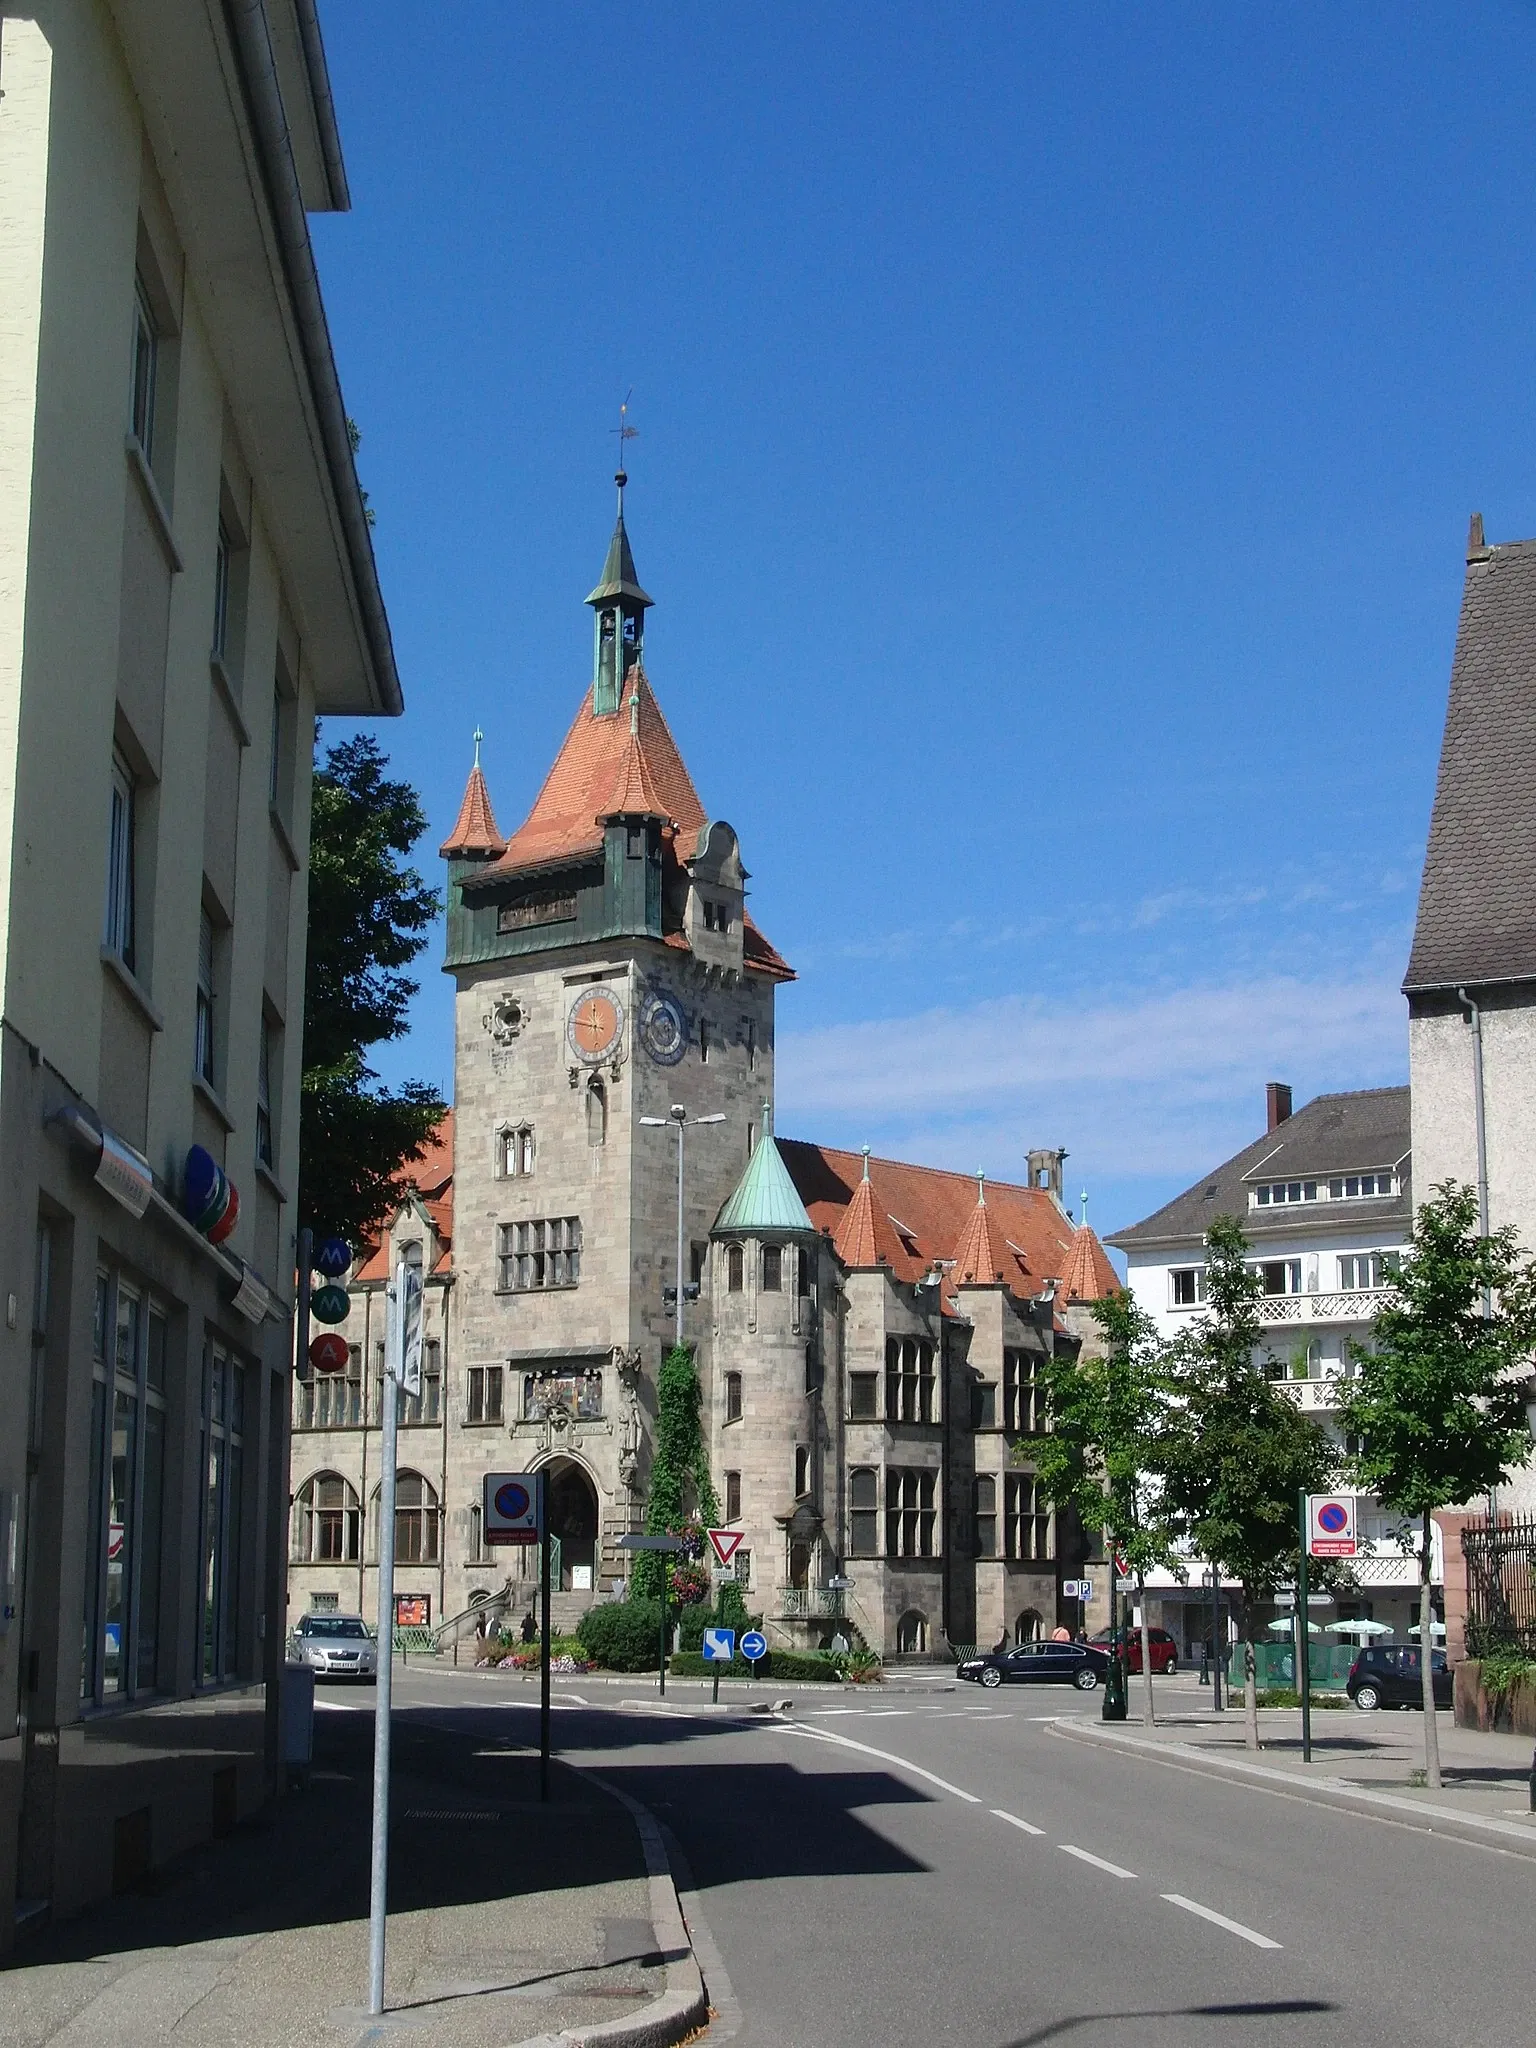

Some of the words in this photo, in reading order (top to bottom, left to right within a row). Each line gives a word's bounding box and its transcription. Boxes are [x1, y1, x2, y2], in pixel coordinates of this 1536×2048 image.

[320, 1247, 344, 1265] M
[319, 1295, 342, 1312] M
[319, 1342, 337, 1361] A
[1082, 1583, 1089, 1594] P
